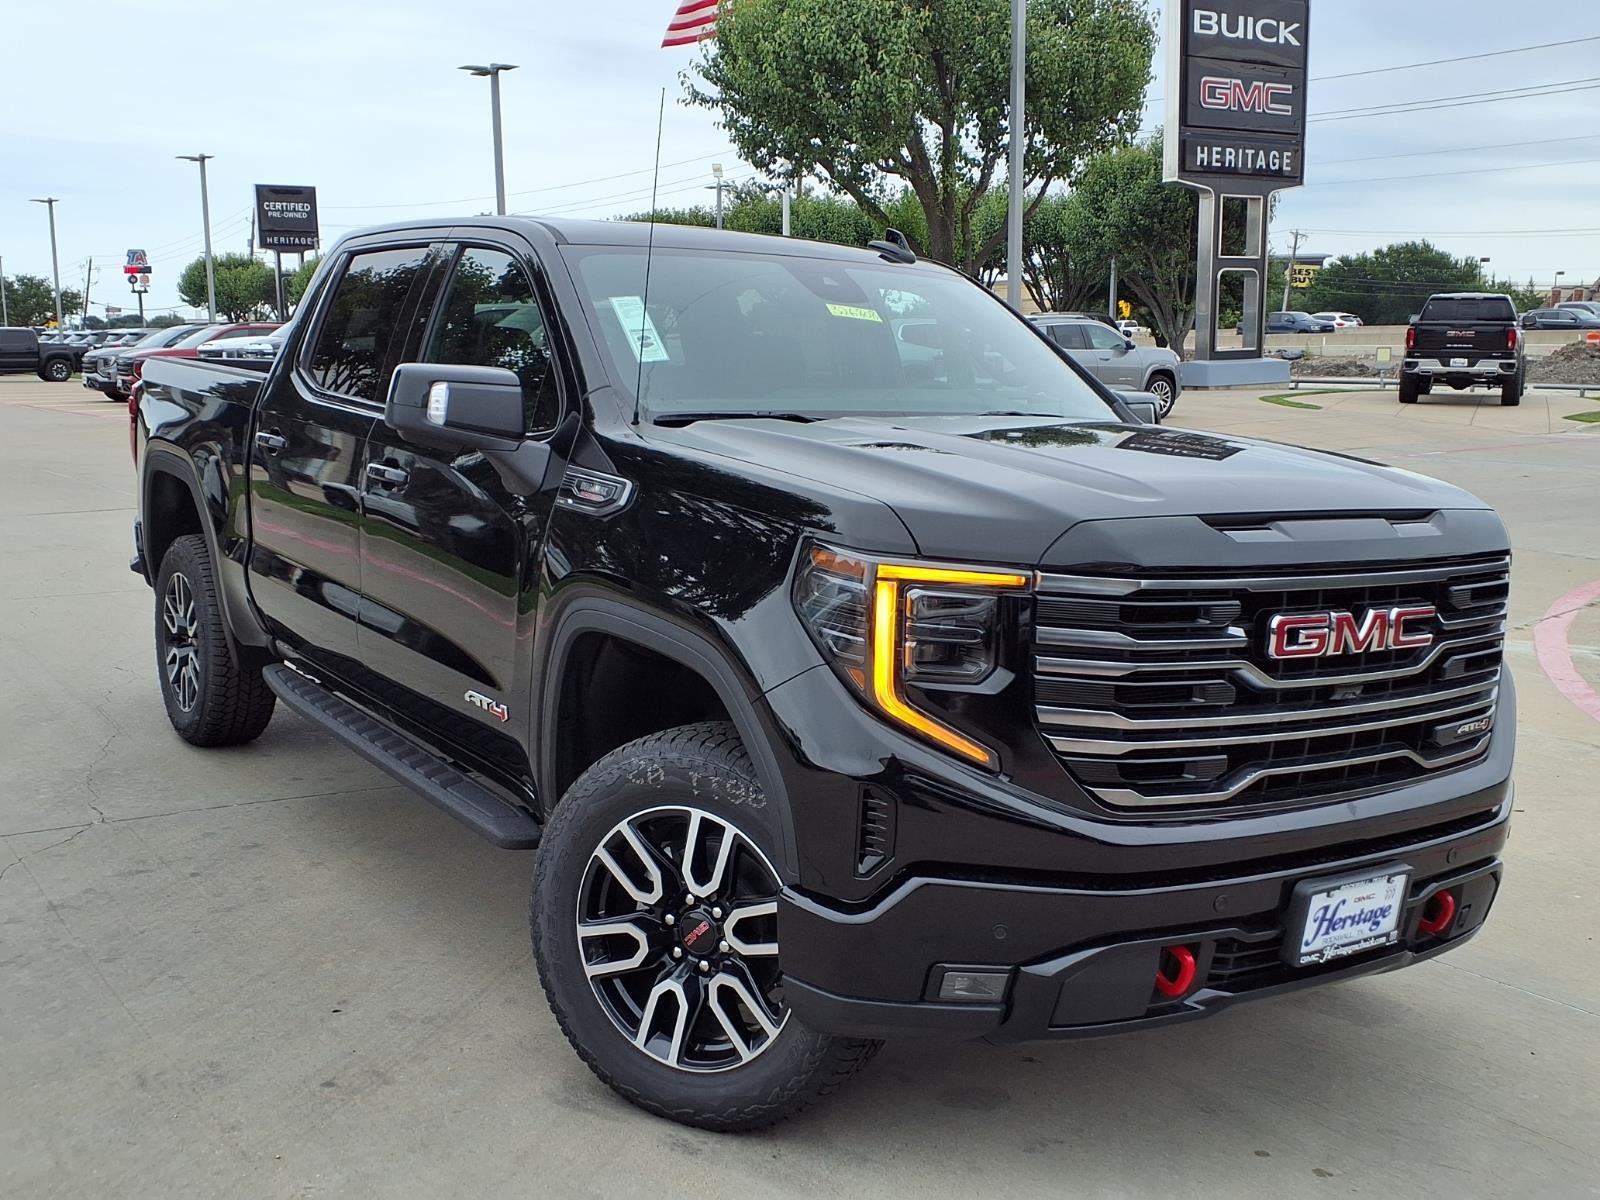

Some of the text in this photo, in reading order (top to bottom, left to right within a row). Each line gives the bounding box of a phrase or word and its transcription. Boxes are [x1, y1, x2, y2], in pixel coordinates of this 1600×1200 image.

[1193, 9, 1301, 46] BUICK
[1200, 76, 1293, 116] GMC
[1196, 146, 1292, 171] HERITAGE
[263, 201, 311, 212] CERTIFIED
[268, 211, 308, 219] PRE-OWNED
[266, 236, 314, 245] HERITAGE
[1268, 605, 1436, 659] GMC
[464, 689, 508, 722] AT4
[1353, 892, 1377, 903] GMC
[684, 920, 710, 946] GMC
[1303, 898, 1393, 948] Heritage
